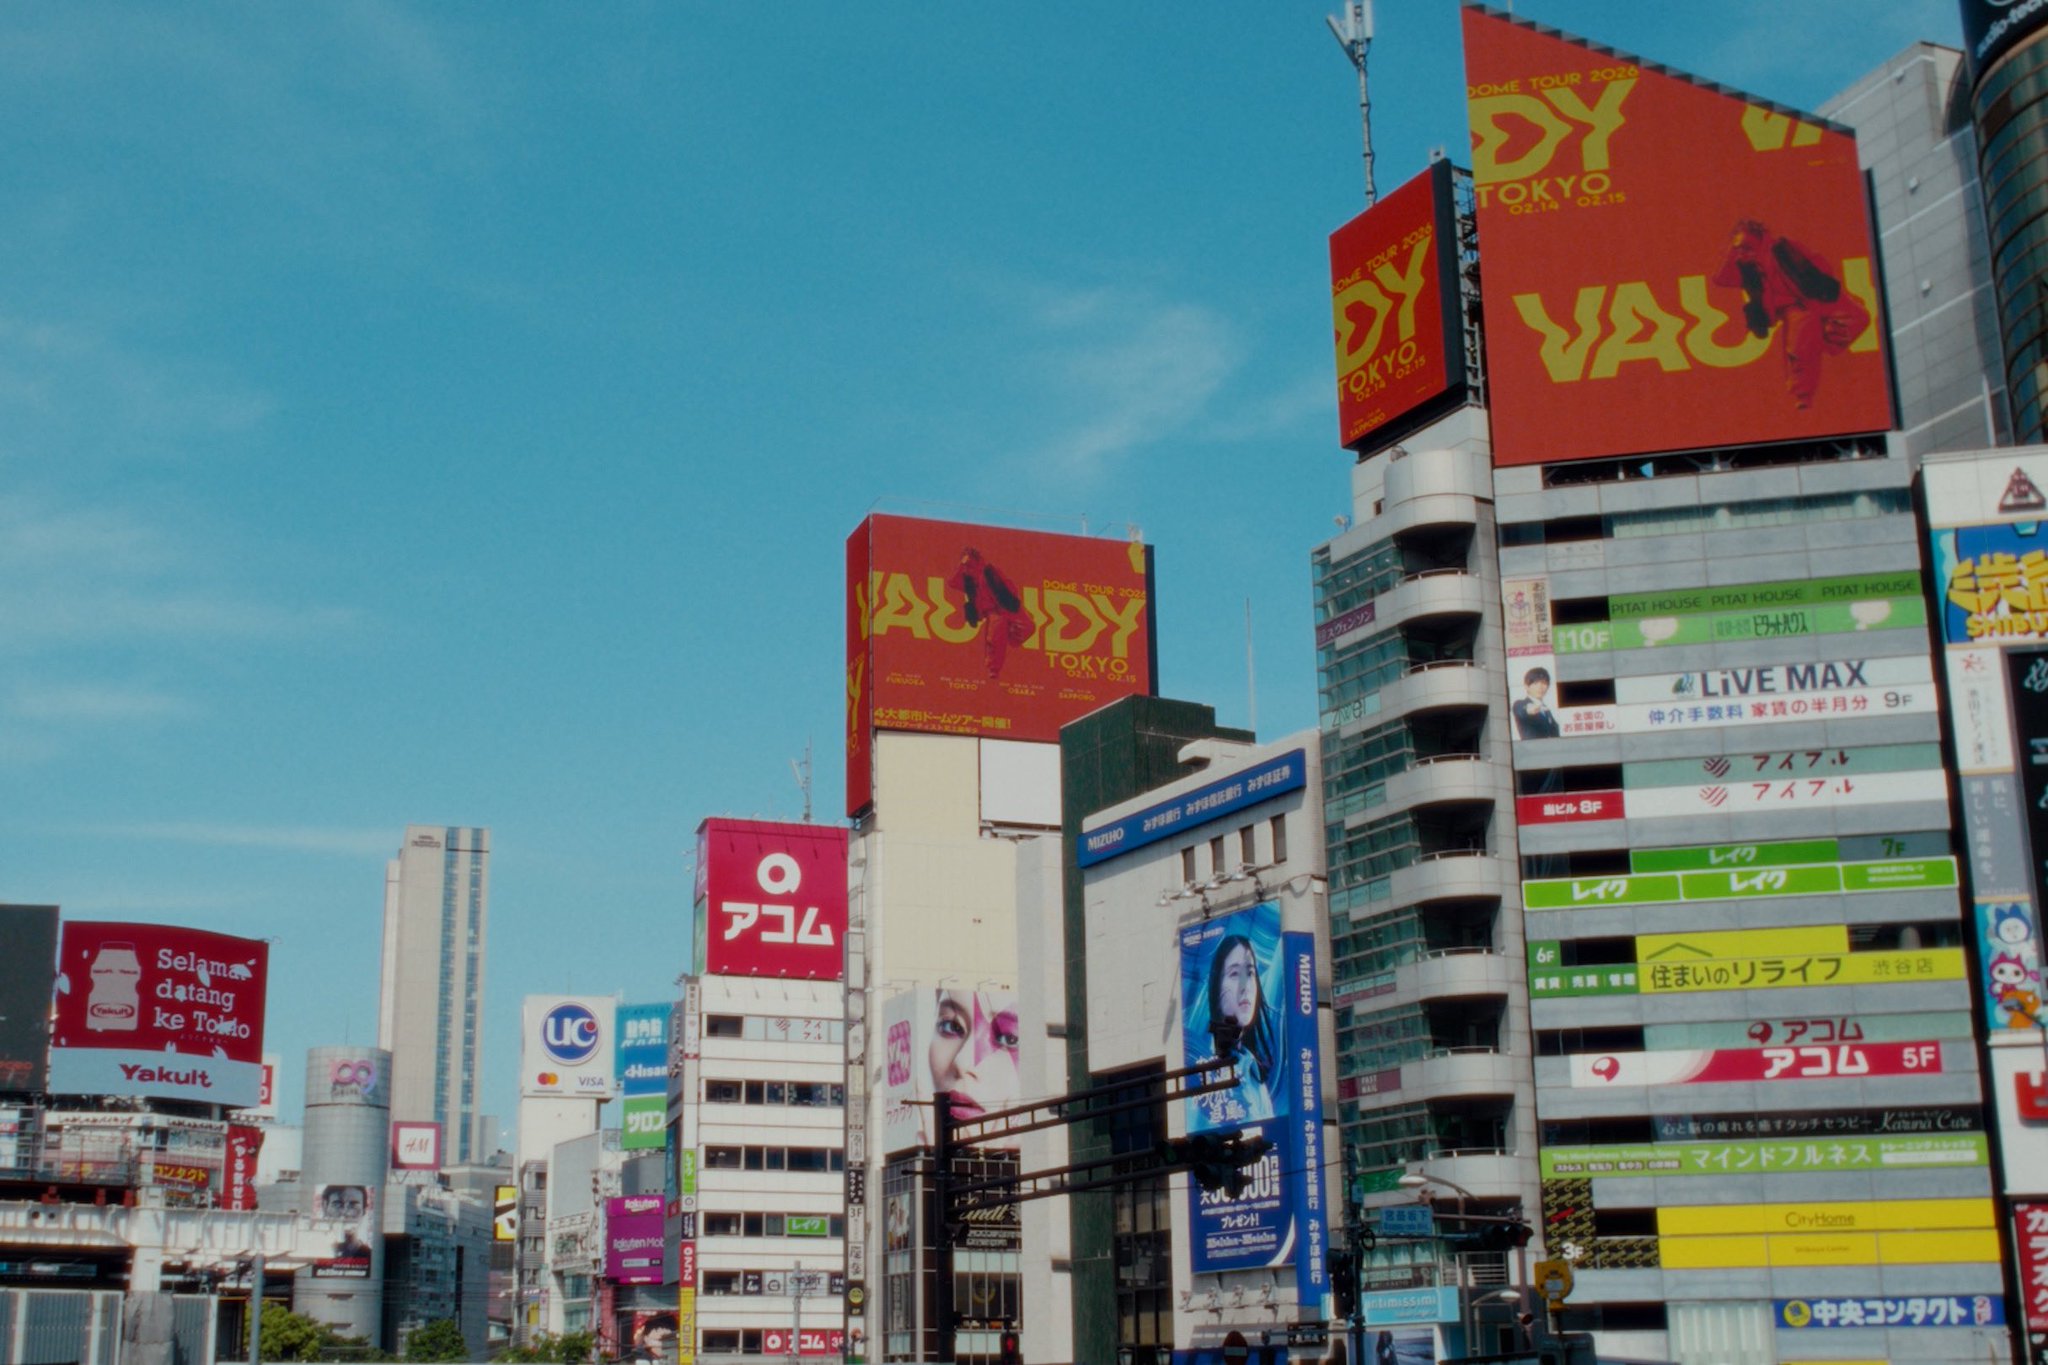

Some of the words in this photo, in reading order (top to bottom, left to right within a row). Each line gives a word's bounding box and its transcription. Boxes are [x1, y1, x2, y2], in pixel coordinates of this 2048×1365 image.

[1529, 73, 1581, 89] TOUR
[1591, 66, 1638, 81] 2026
[1475, 173, 1611, 208] TOKYO
[1509, 200, 1559, 215] 02.14
[1577, 192, 1626, 207] 02.15
[1366, 244, 1398, 272] TOUR
[1403, 223, 1432, 250] 2026
[1338, 340, 1417, 402] TOKYO
[1356, 377, 1386, 402] 02.14
[1396, 356, 1426, 379] 02.15
[1043, 579, 1078, 594] DOME
[1083, 583, 1115, 597] TOUR
[1711, 592, 1747, 607] PITAT
[1752, 588, 1802, 603] HOUSE
[1821, 583, 1859, 598] PITAT
[1867, 579, 1916, 594] HOUSE
[1611, 601, 1648, 615] PITAT
[1652, 596, 1701, 611] HOUSE
[1045, 651, 1129, 675] TOKYO
[1107, 672, 1137, 684] 02.15
[1701, 666, 1777, 698] LiVE
[1786, 660, 1869, 691] MAX
[1573, 710, 1605, 722] 全国の
[1648, 704, 1743, 726] 仲介手数料
[1750, 694, 1869, 718] 家賃の半月分
[1884, 690, 1913, 709] 9F
[1563, 720, 1615, 734] お部屋探し
[1752, 750, 1850, 772] アイフル
[1752, 778, 1854, 801] アイフル
[1578, 799, 1603, 814] 8F
[1087, 826, 1125, 852] MIZUHO
[1142, 806, 1182, 833] みずほ銀行
[1709, 845, 1758, 865] レイク
[1881, 837, 1906, 857] 7F
[1572, 878, 1629, 900] レイク
[1729, 870, 1788, 892] レイク
[721, 901, 835, 946] アコム
[1535, 947, 1556, 964] 6F
[1298, 953, 1314, 1016] MIZUHO
[1650, 957, 1842, 990] 住まいのリライフ
[1871, 957, 1935, 977] 渋谷店
[155, 978, 236, 1013] datang
[153, 1006, 186, 1031] ke
[1781, 1018, 1865, 1045] アコム
[1763, 1045, 1870, 1080] アコム
[1901, 1046, 1937, 1070] 5F
[118, 1063, 213, 1089] Yakult
[577, 1076, 605, 1088] VISA
[1301, 1047, 1315, 1112] みずほ証券
[1691, 1143, 1873, 1169] マインドフルネス
[154, 1164, 208, 1182] コンタクト
[849, 1207, 863, 1219] 3F
[791, 1219, 821, 1232] レイク
[1308, 1218, 1322, 1285] みずほ銀行
[1561, 1241, 1585, 1260] 3F
[1812, 1297, 1967, 1327] 中央コンタクト
